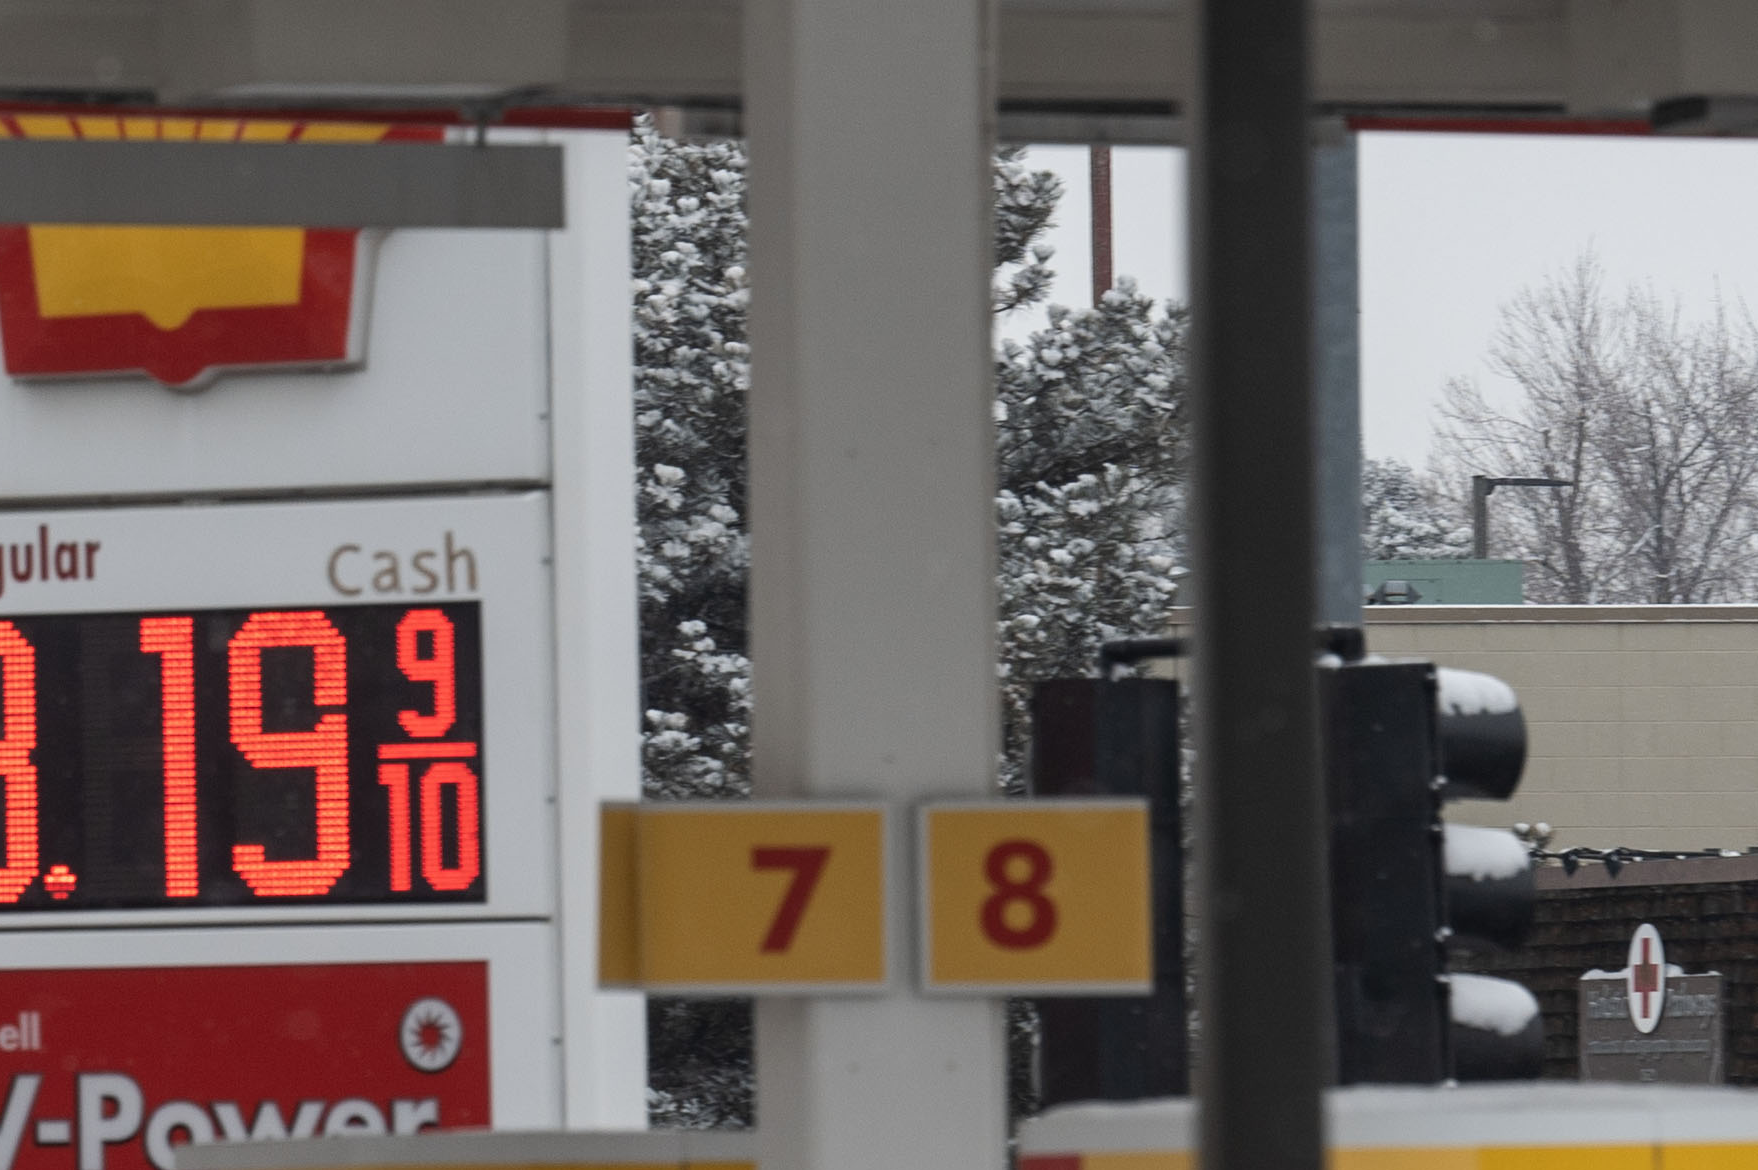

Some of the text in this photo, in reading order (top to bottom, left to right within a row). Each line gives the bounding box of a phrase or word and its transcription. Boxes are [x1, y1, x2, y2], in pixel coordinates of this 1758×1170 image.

[327, 533, 478, 596] Cash
[750, 846, 832, 954] 7
[978, 837, 1059, 954] 8
